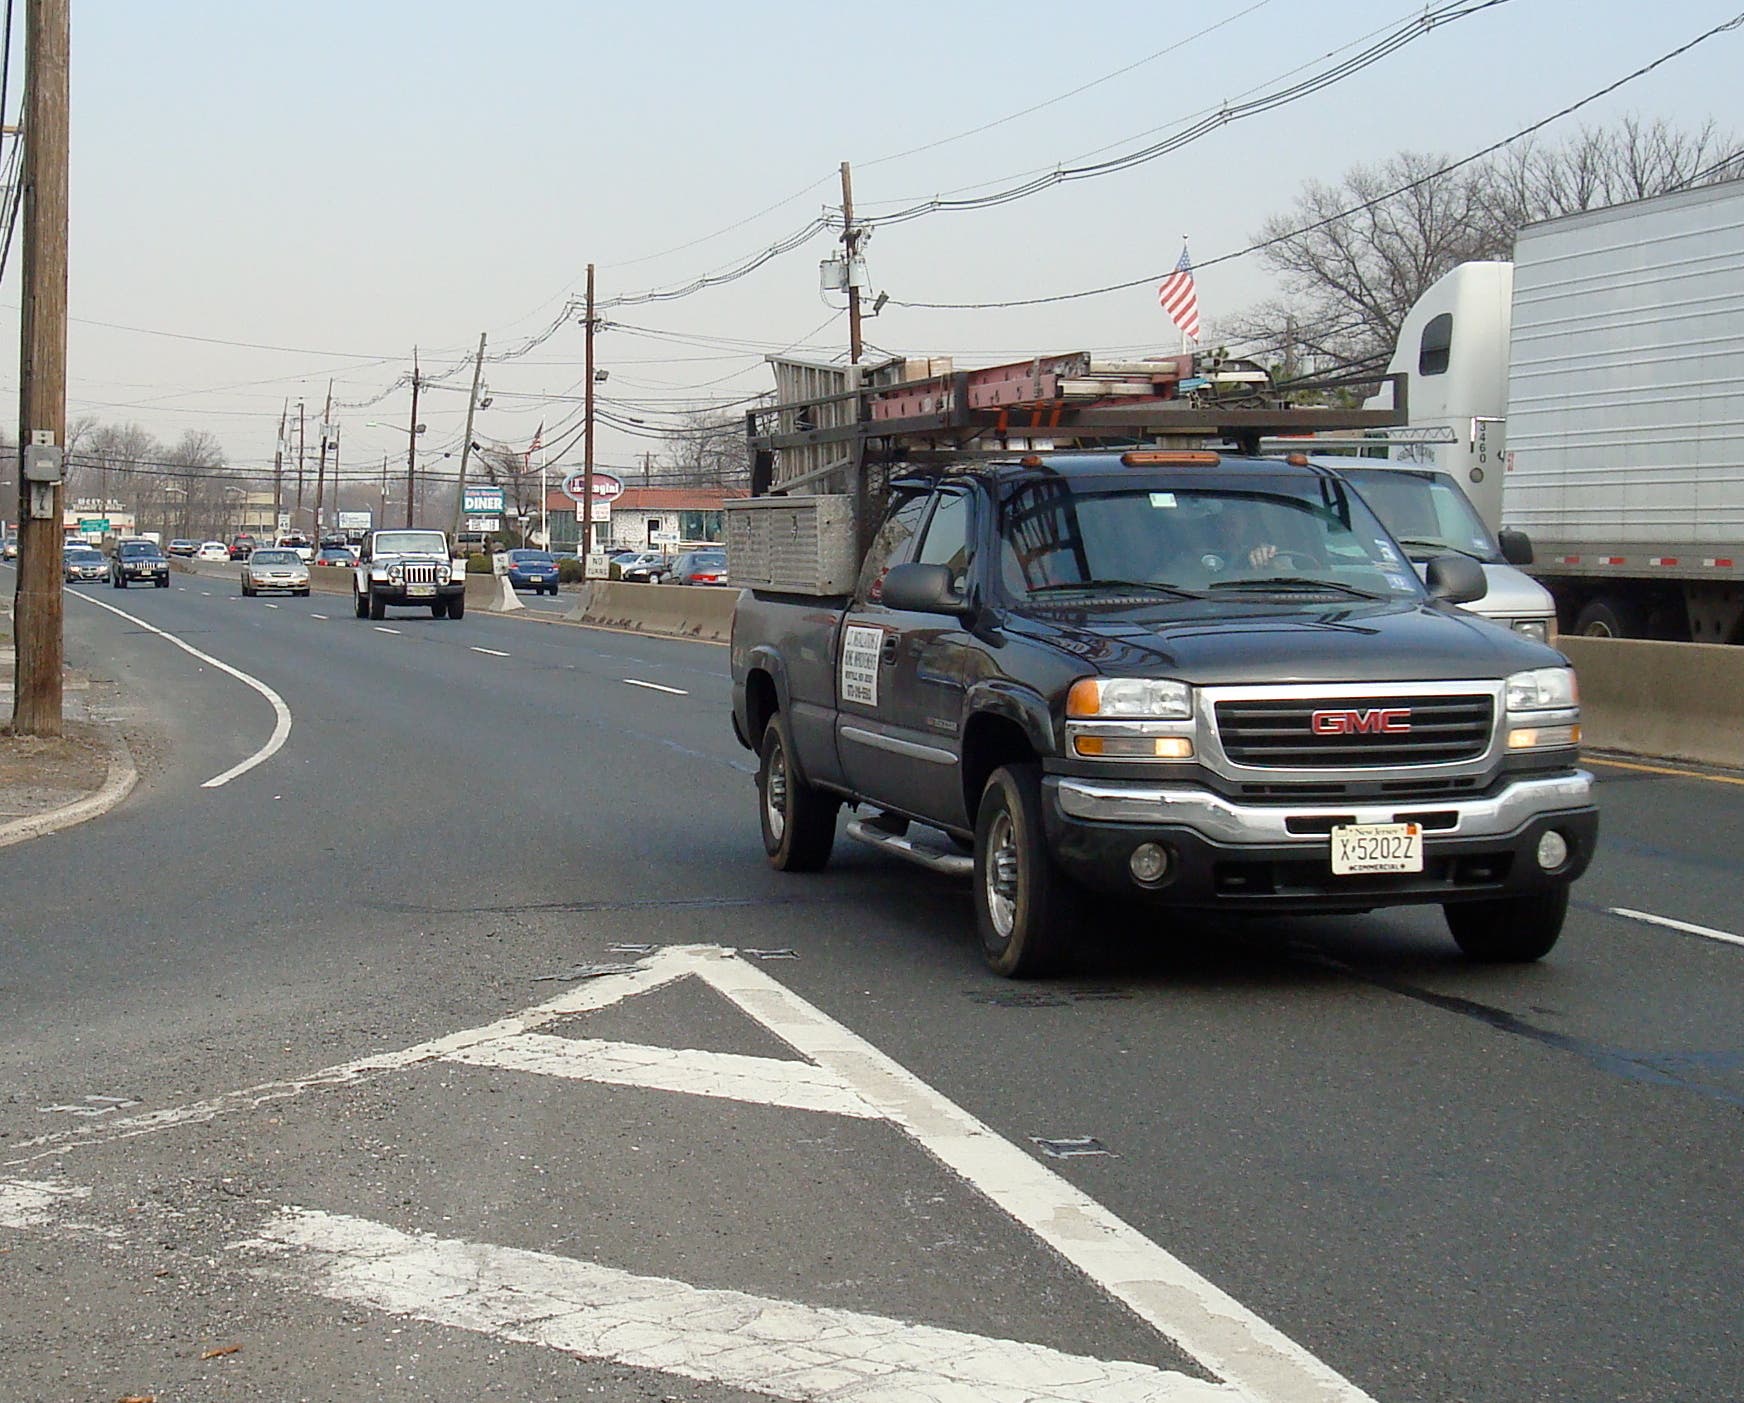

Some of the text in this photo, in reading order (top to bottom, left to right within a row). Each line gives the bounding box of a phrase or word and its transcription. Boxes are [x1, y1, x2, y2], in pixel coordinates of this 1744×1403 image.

[1479, 421, 1487, 464] 3460
[464, 496, 503, 510] DINER
[279, 521, 289, 529] 45
[1312, 708, 1412, 735] GMC
[1353, 863, 1400, 871] COMMERCIAL
